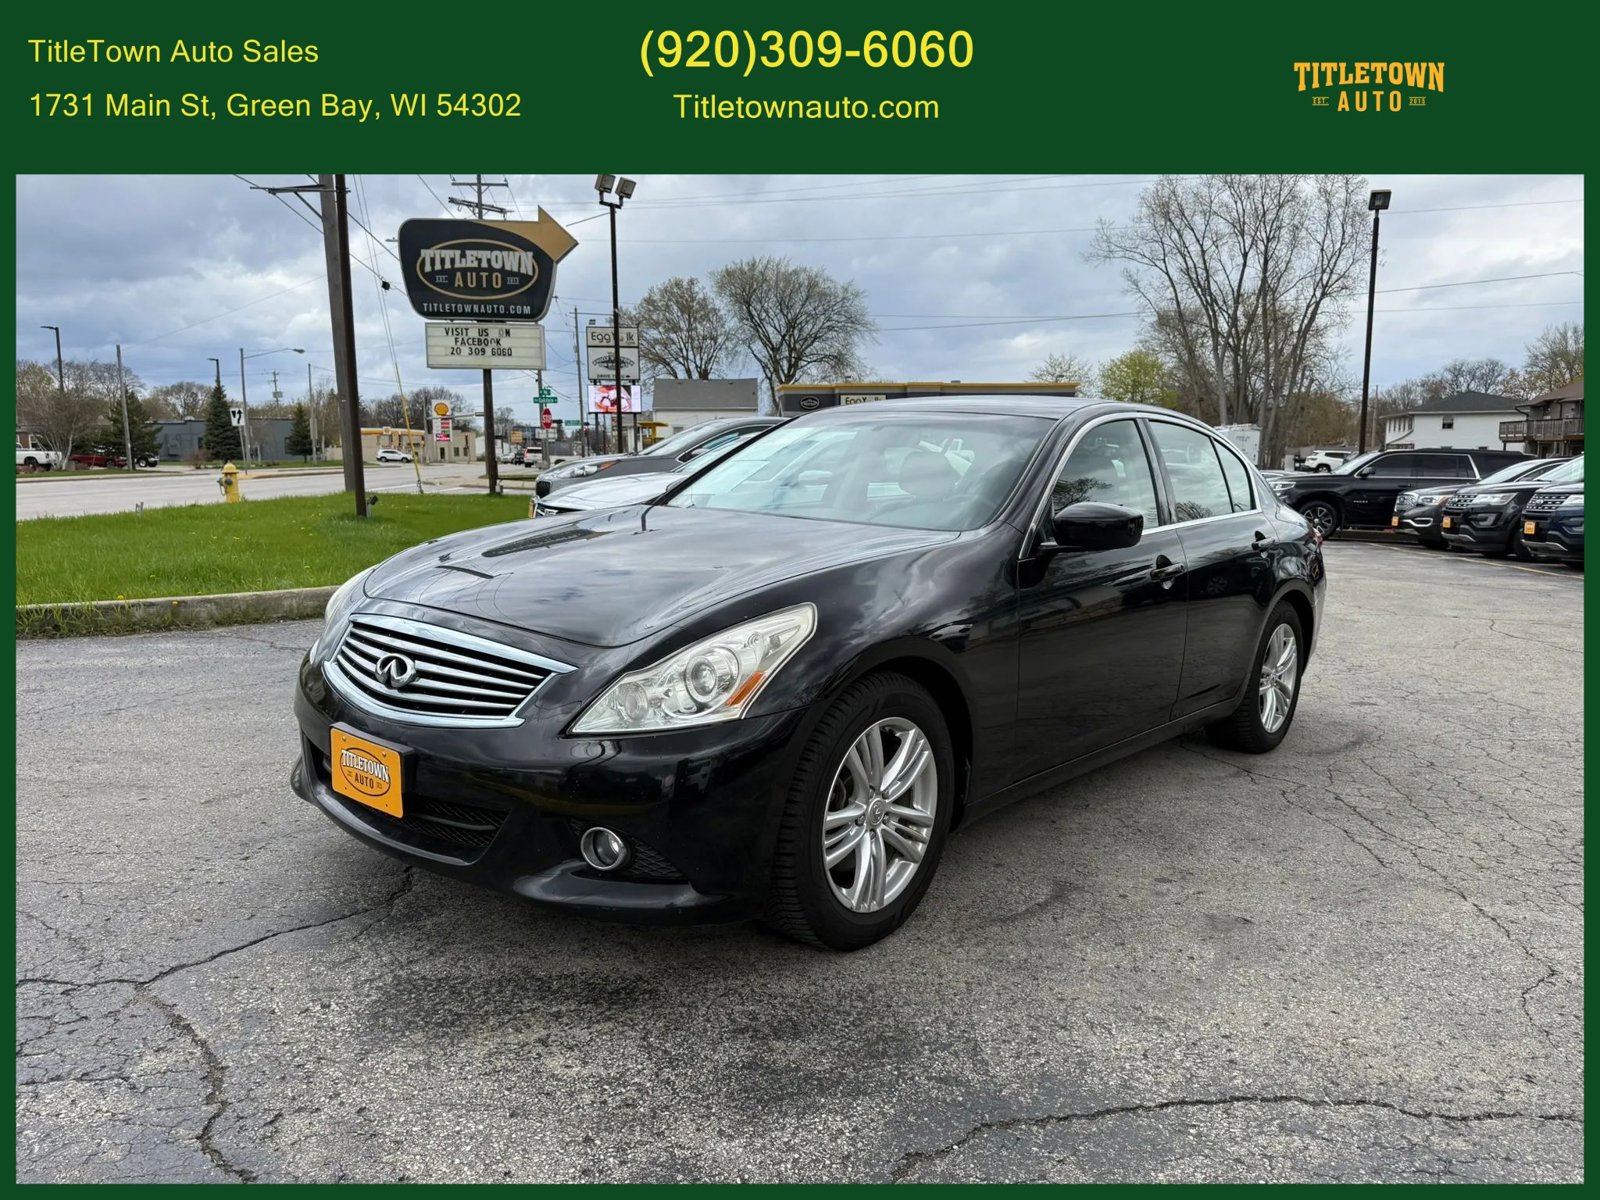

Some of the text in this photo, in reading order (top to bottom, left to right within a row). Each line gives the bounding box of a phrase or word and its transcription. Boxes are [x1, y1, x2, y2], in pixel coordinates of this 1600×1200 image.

[420, 249, 534, 276] TITLETOWN
[454, 271, 502, 289] AUTO
[422, 303, 531, 314] TITLETOWNAUTO.COM
[444, 328, 469, 337] VISIT
[477, 328, 489, 337] US
[468, 347, 486, 356] 309
[491, 347, 513, 357] 6060
[341, 750, 390, 784] TITLETOWN
[354, 773, 374, 790] AUTO
